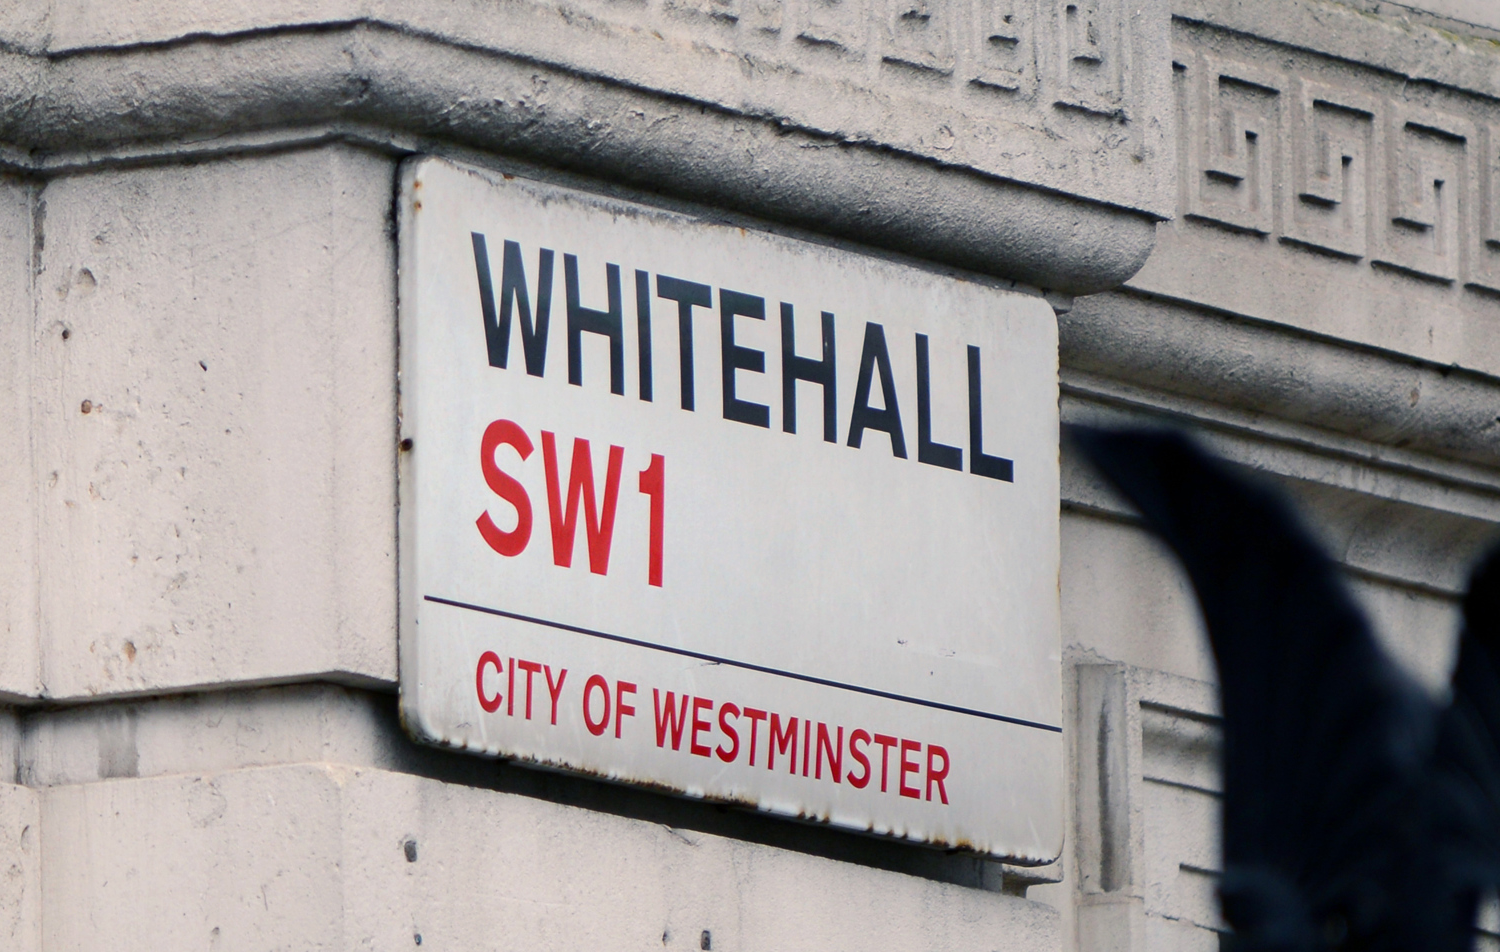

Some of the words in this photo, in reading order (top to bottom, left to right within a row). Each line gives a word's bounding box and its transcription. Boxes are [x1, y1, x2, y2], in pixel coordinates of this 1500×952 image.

[472, 233, 1013, 482] WHITEHALL
[476, 419, 665, 587] SW1
[476, 651, 567, 724] CITY
[583, 675, 637, 738] OF
[653, 688, 950, 804] WESTMINSTER
